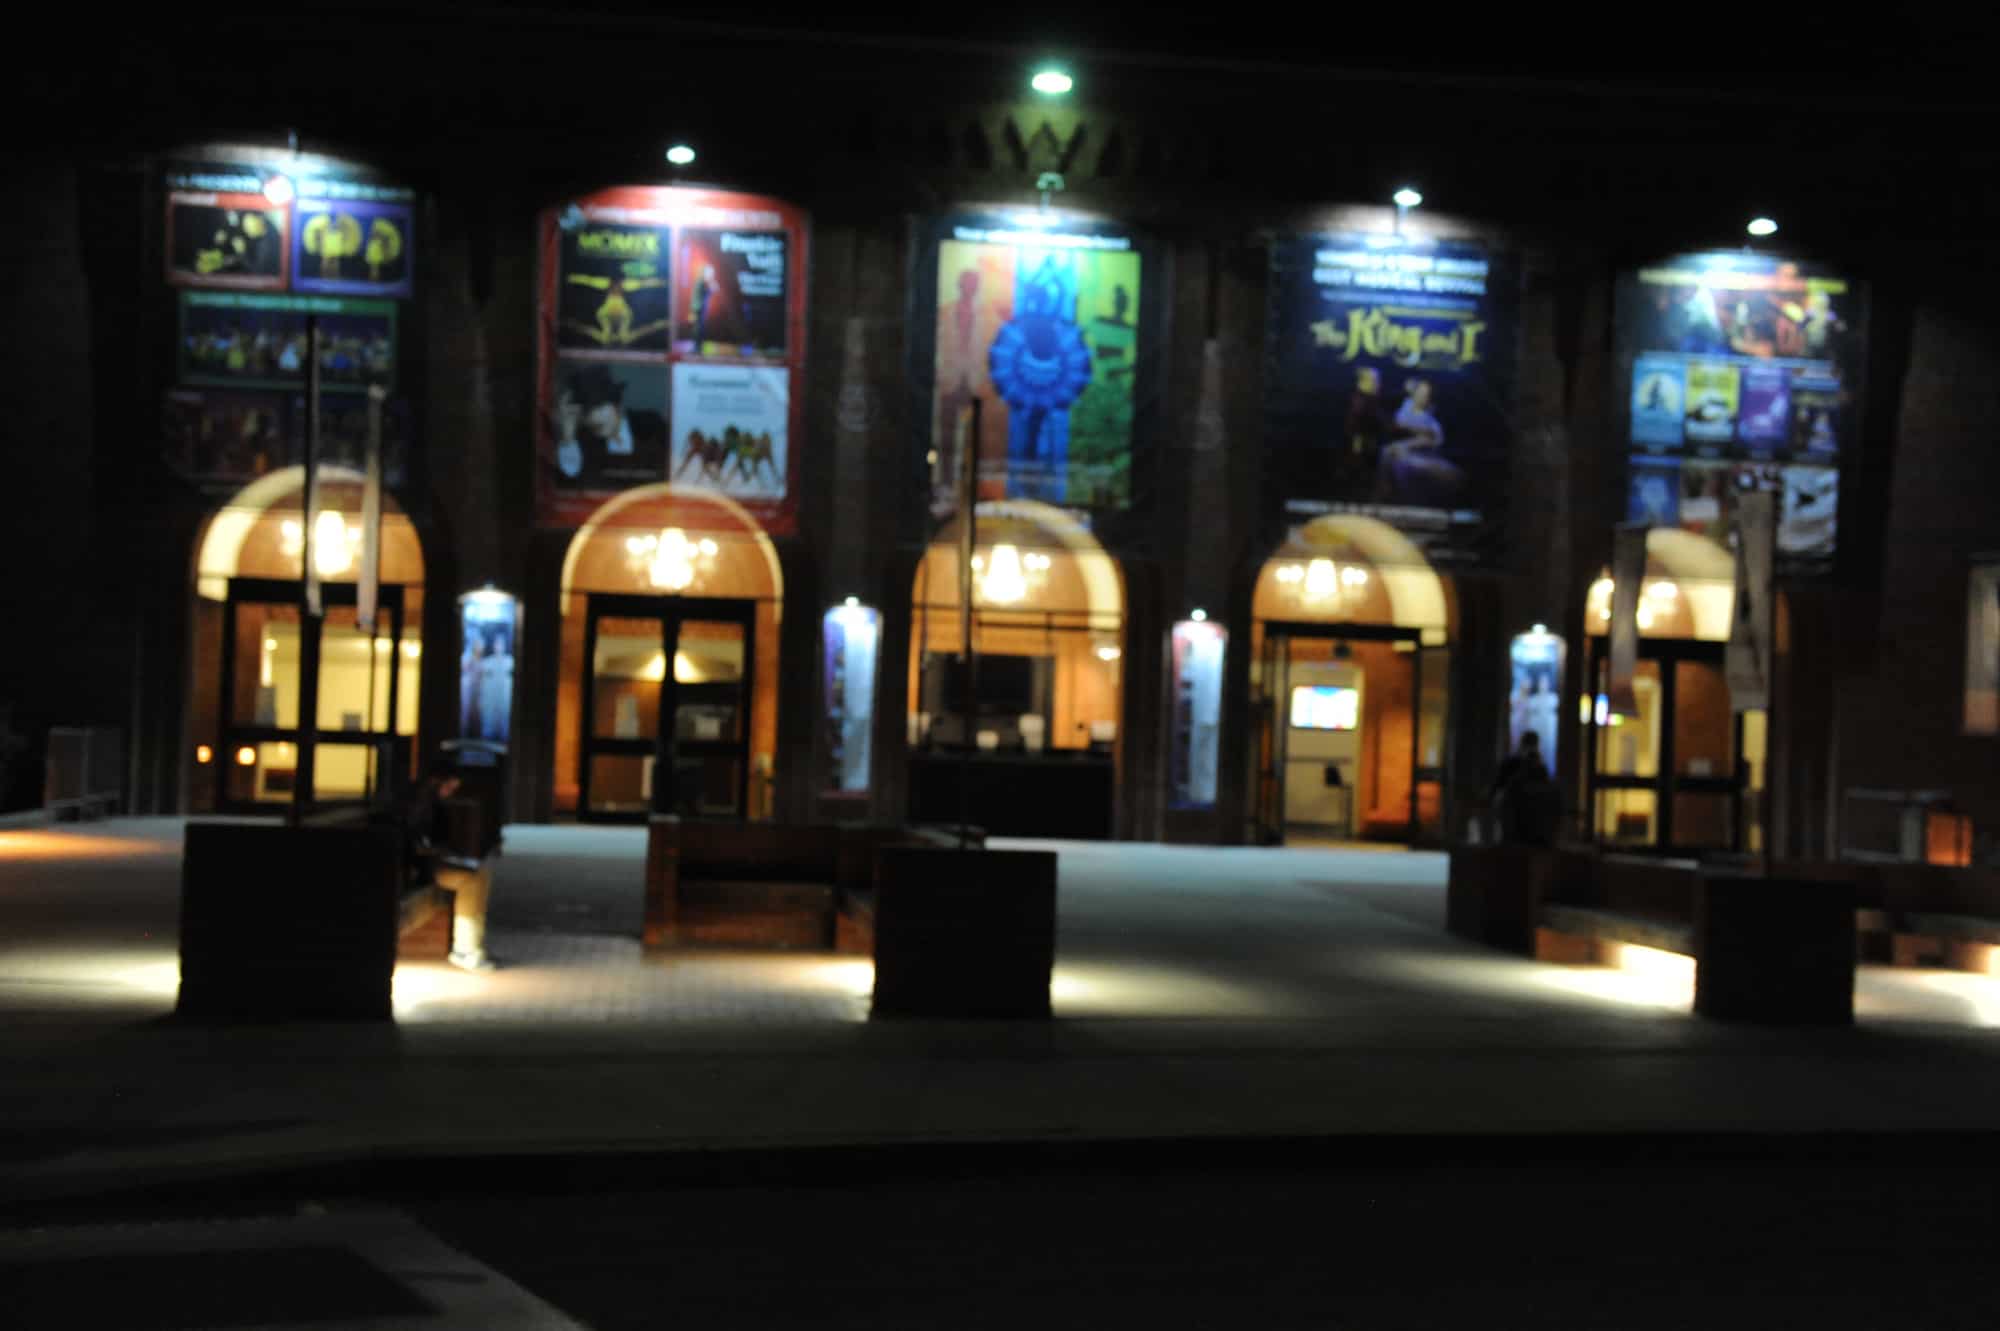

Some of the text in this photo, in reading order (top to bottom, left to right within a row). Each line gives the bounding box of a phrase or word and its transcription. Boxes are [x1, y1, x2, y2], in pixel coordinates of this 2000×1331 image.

[578, 231, 658, 253] MOMIX
[1353, 270, 1422, 291] MUSICAL
[1310, 317, 1347, 348] The
[1344, 307, 1423, 367] King
[1422, 329, 1457, 353] and
[1458, 320, 1487, 364] I
